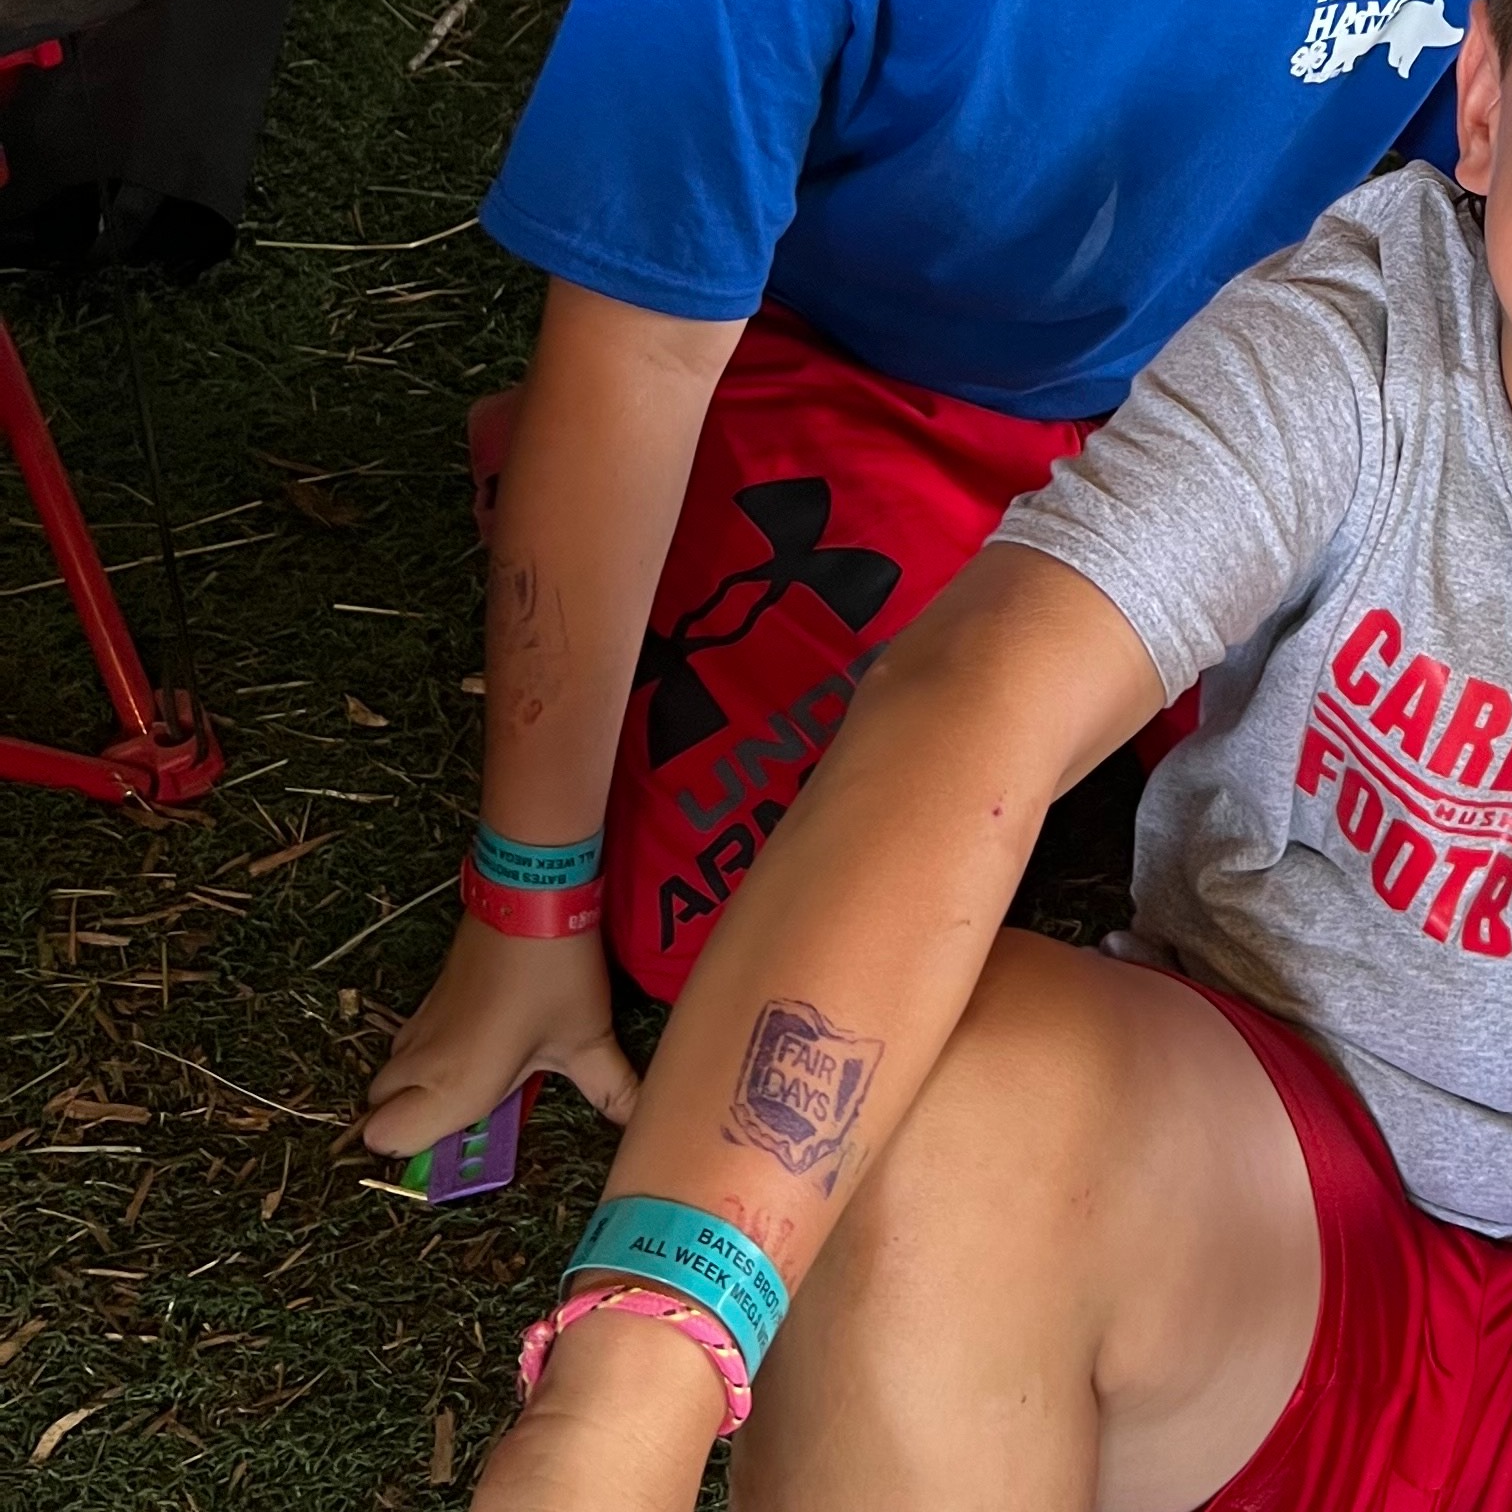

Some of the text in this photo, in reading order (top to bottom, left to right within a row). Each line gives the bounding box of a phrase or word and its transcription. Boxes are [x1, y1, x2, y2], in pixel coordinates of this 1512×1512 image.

[523, 872, 567, 885] BATES
[536, 856, 575, 870] WEEK
[777, 1037, 837, 1085] FAIR
[761, 1066, 831, 1122] DAYS
[697, 1228, 753, 1276] BATES
[629, 1236, 667, 1258] ALL
[675, 1246, 732, 1289] WEEK
[730, 1282, 762, 1329] MEGA
